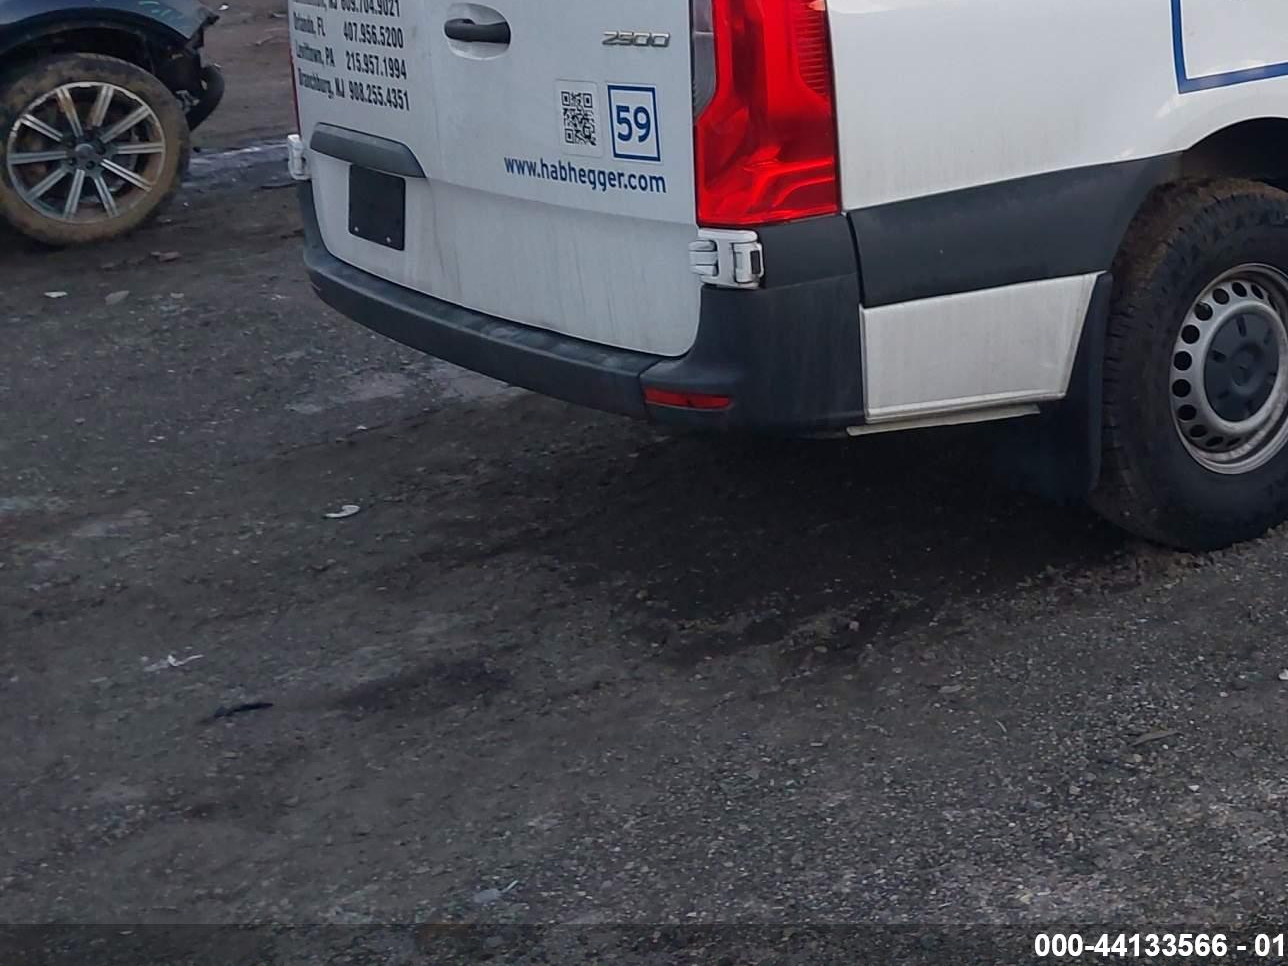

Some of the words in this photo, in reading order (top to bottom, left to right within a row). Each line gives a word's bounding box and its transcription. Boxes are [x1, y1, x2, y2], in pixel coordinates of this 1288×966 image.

[343, 21, 404, 49] 407.956.5200
[602, 31, 670, 48] 2500
[346, 50, 407, 80] 215.957.1994
[348, 80, 410, 111] 908.255.4351
[616, 105, 651, 143] 59
[504, 156, 666, 194] www.habhegger.com
